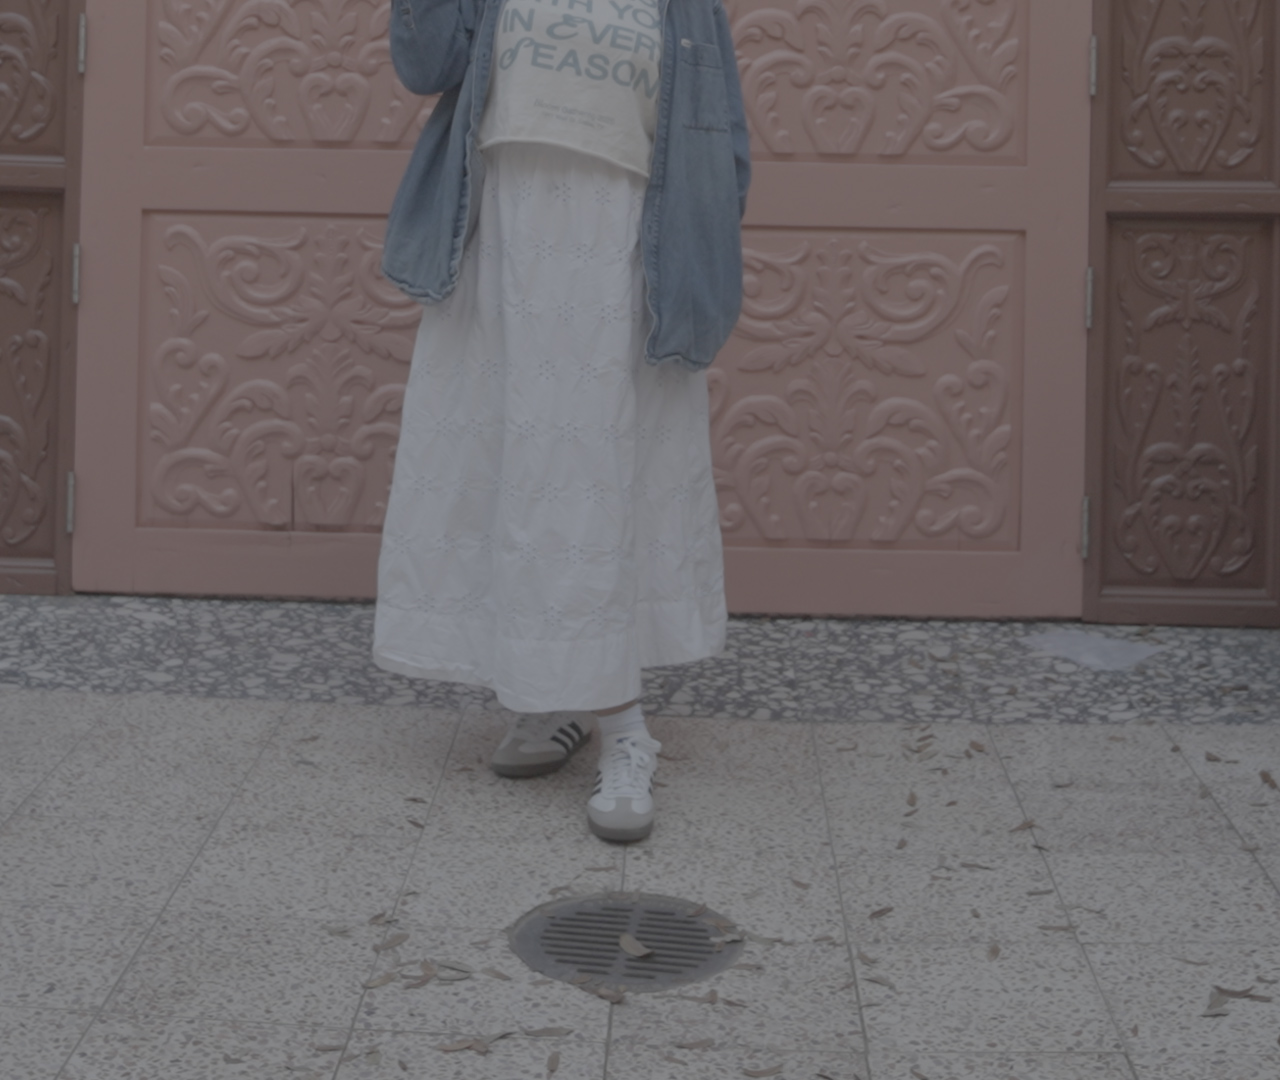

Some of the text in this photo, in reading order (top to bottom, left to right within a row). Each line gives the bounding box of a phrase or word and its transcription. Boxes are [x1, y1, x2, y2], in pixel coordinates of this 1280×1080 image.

[502, 8, 535, 33] IN
[608, 0, 661, 30] YO
[498, 36, 659, 100] SEASON
